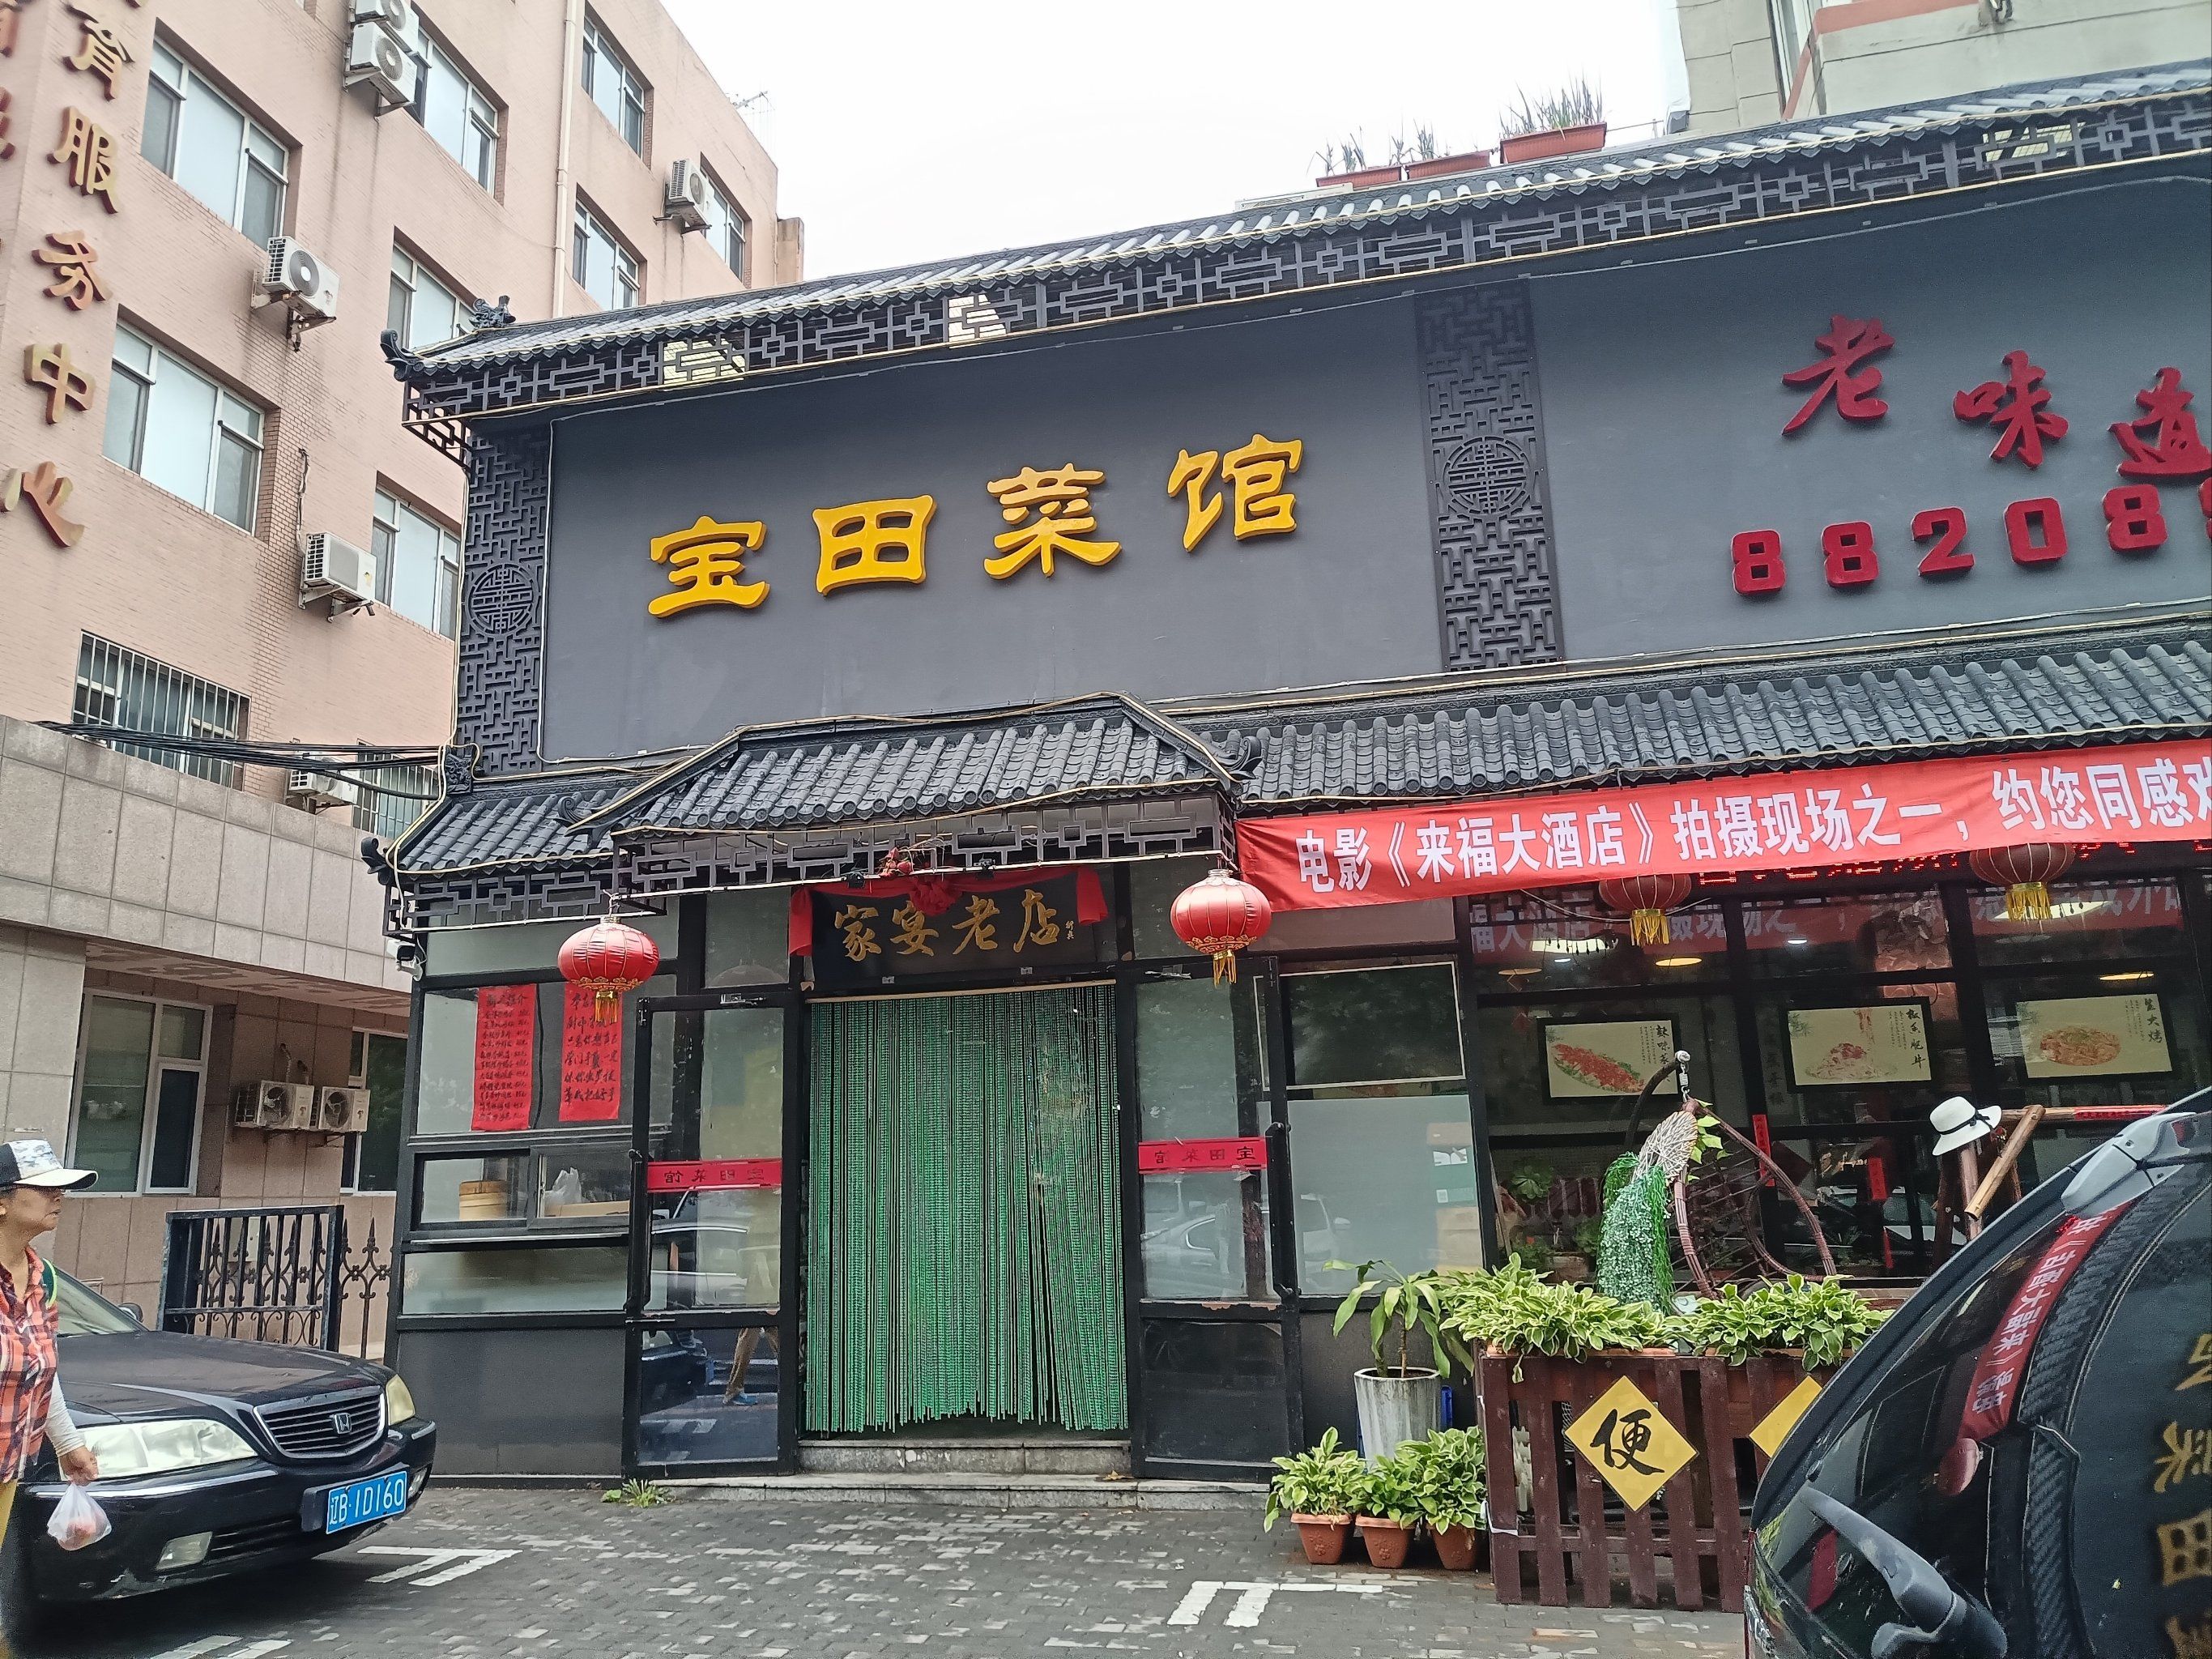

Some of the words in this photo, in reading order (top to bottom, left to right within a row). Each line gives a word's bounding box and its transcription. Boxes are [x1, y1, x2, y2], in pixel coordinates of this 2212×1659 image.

[1782, 313, 2212, 480] 老味道
[648, 433, 1304, 619] 宝田菜馆
[1730, 476, 2212, 595] 88208
[834, 889, 1060, 962] 家宴老店
[1589, 1408, 1665, 1476] 便
